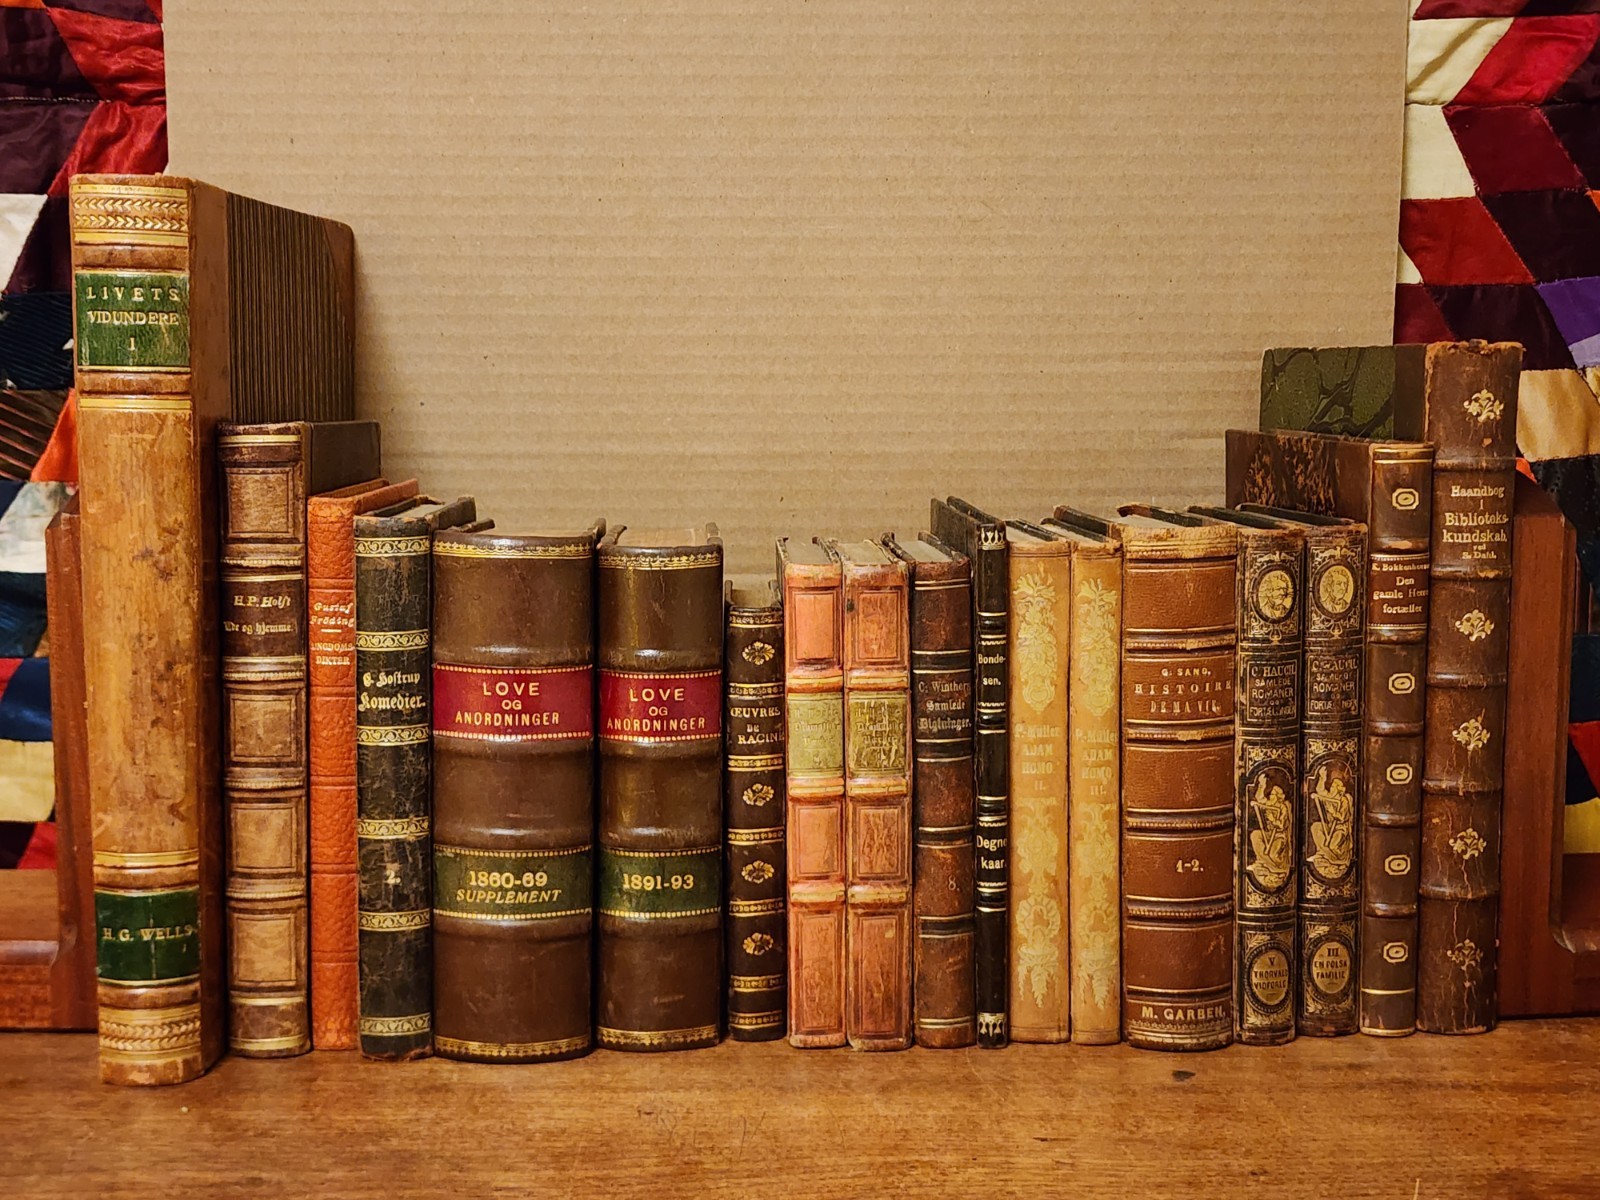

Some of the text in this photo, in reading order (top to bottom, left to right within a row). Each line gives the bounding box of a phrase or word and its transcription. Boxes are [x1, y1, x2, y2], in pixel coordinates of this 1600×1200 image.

[86, 286, 180, 301] LIVETS
[86, 310, 179, 326] VIDUNDERE
[1451, 485, 1504, 498] Haandbog
[1396, 576, 1414, 586] Den
[1373, 590, 1404, 600] gamle
[314, 602, 354, 614] Gustaf
[316, 656, 351, 666] DIKTER
[978, 654, 1006, 664] Bonde-
[982, 677, 1002, 686] sen.
[1134, 680, 1232, 694] HISTOIRE
[482, 682, 540, 696] LOVE
[630, 688, 684, 702] LOVE
[1252, 688, 1294, 698] ROMANER
[358, 692, 426, 712] Komedier.
[502, 700, 522, 710] OG
[1150, 701, 1166, 713] DE
[1173, 701, 1190, 713] MA
[648, 706, 668, 716] OG
[455, 710, 560, 726] ANORDNINGER
[606, 717, 705, 732] ANORDNINGER
[746, 724, 760, 732] DE
[1082, 748, 1113, 760] ADAM
[469, 870, 548, 888] 1860-69
[623, 874, 694, 891] 1891-93
[948, 875, 960, 890] 8.
[456, 888, 562, 904] SUPPLEMENT
[1327, 948, 1339, 957] III
[1268, 956, 1276, 966] V
[1142, 1006, 1158, 1019] M.
